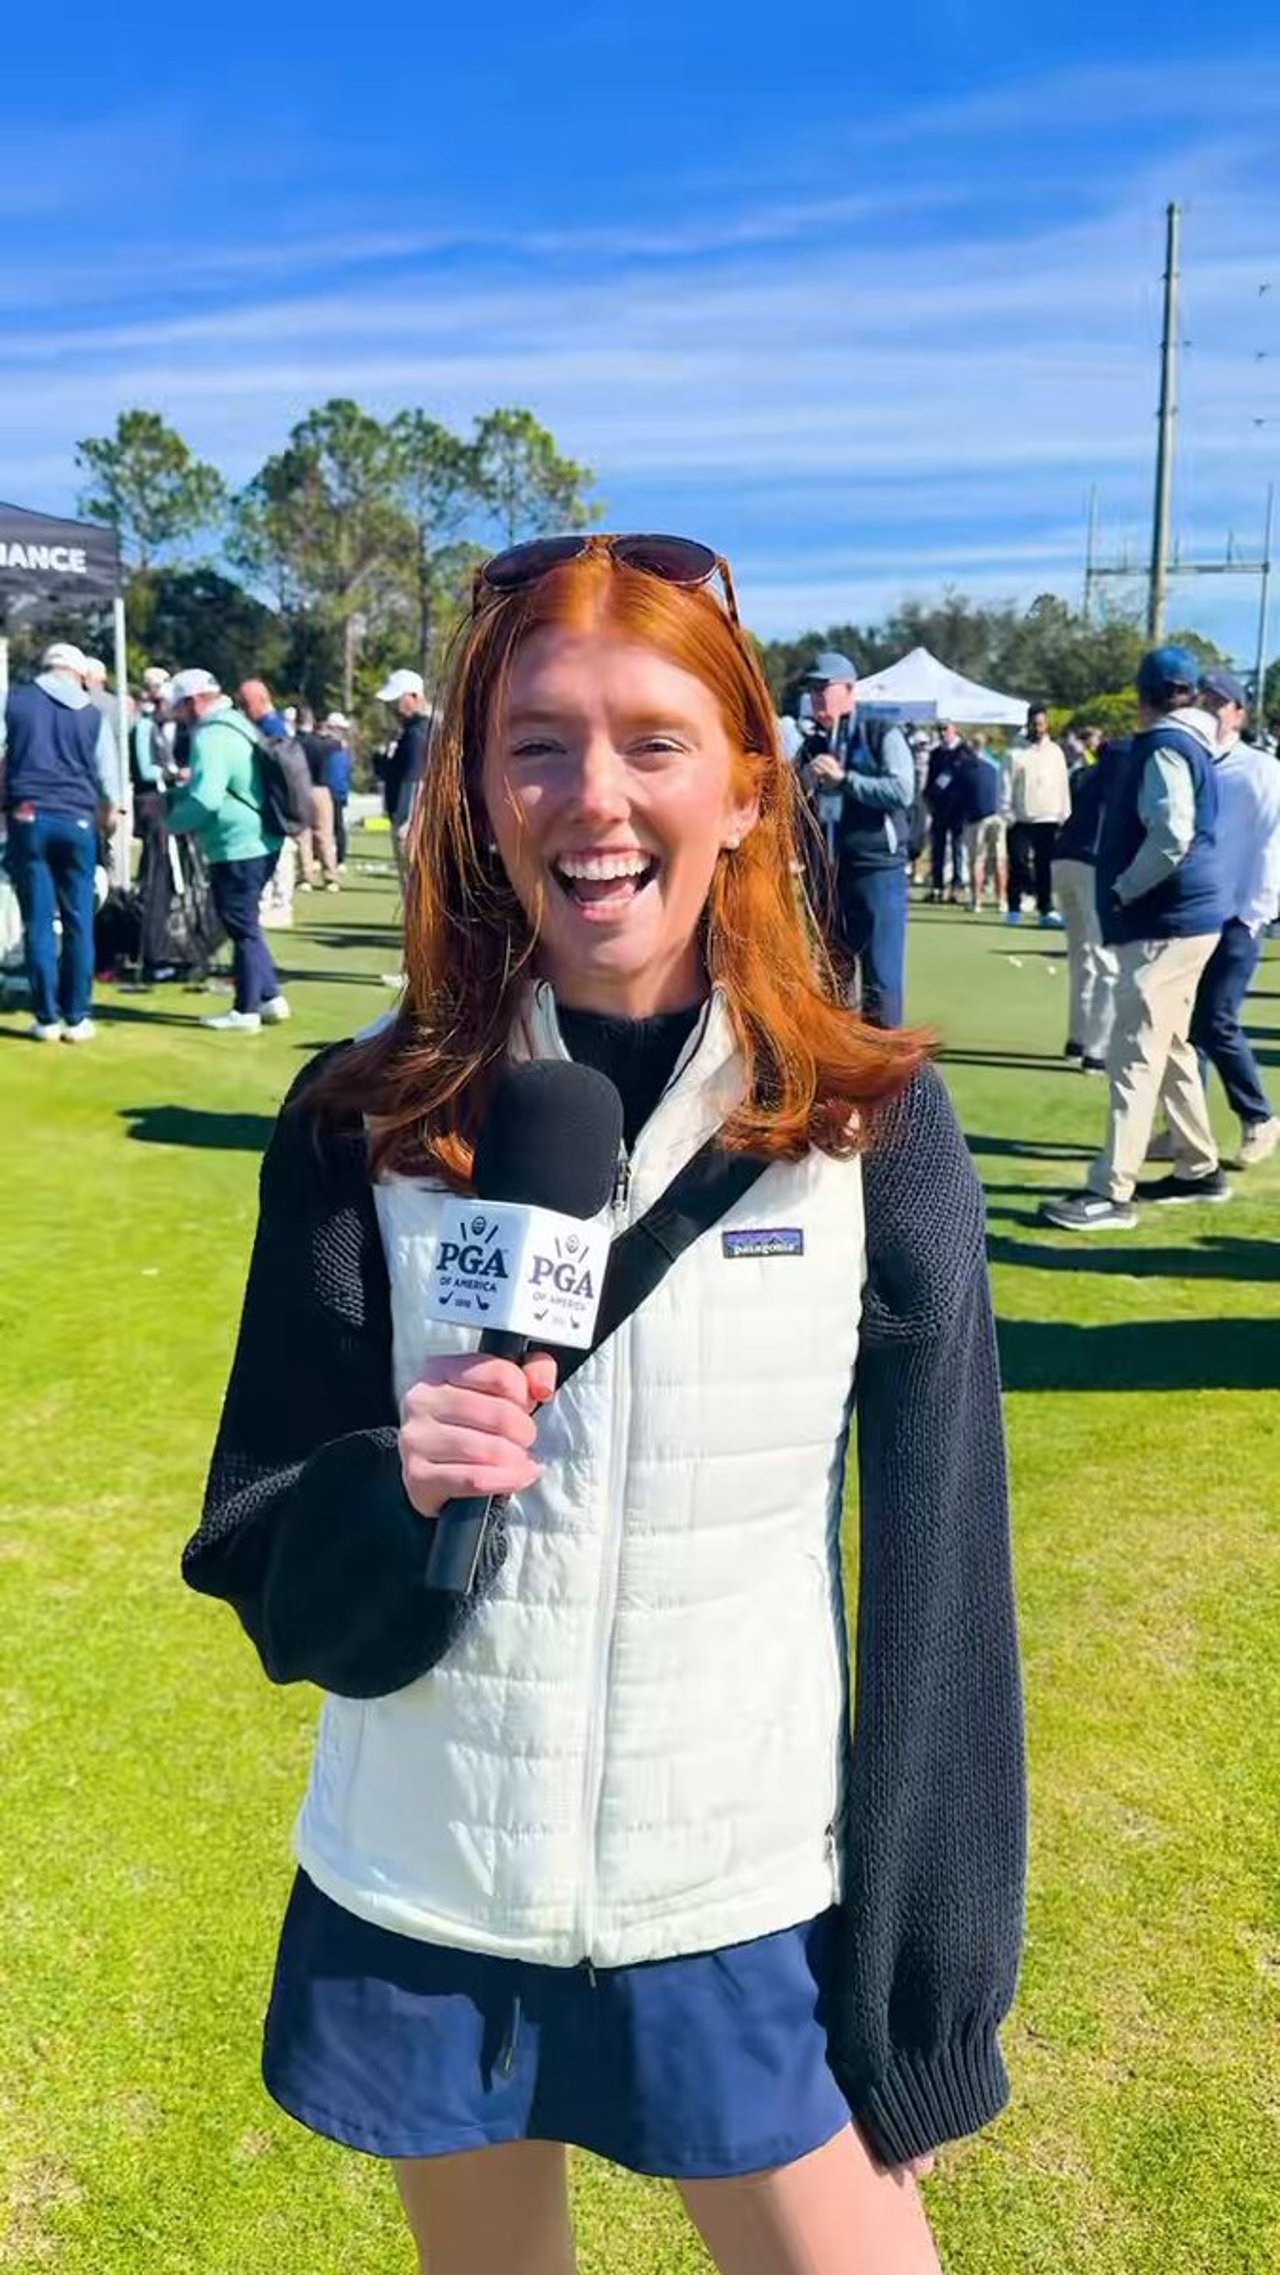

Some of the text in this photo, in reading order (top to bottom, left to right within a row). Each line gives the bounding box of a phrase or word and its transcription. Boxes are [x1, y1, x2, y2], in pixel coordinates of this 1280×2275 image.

[436, 1242, 509, 1279] PGA
[528, 1255, 594, 1299] PGA
[439, 1276, 497, 1293] OF AMERICA
